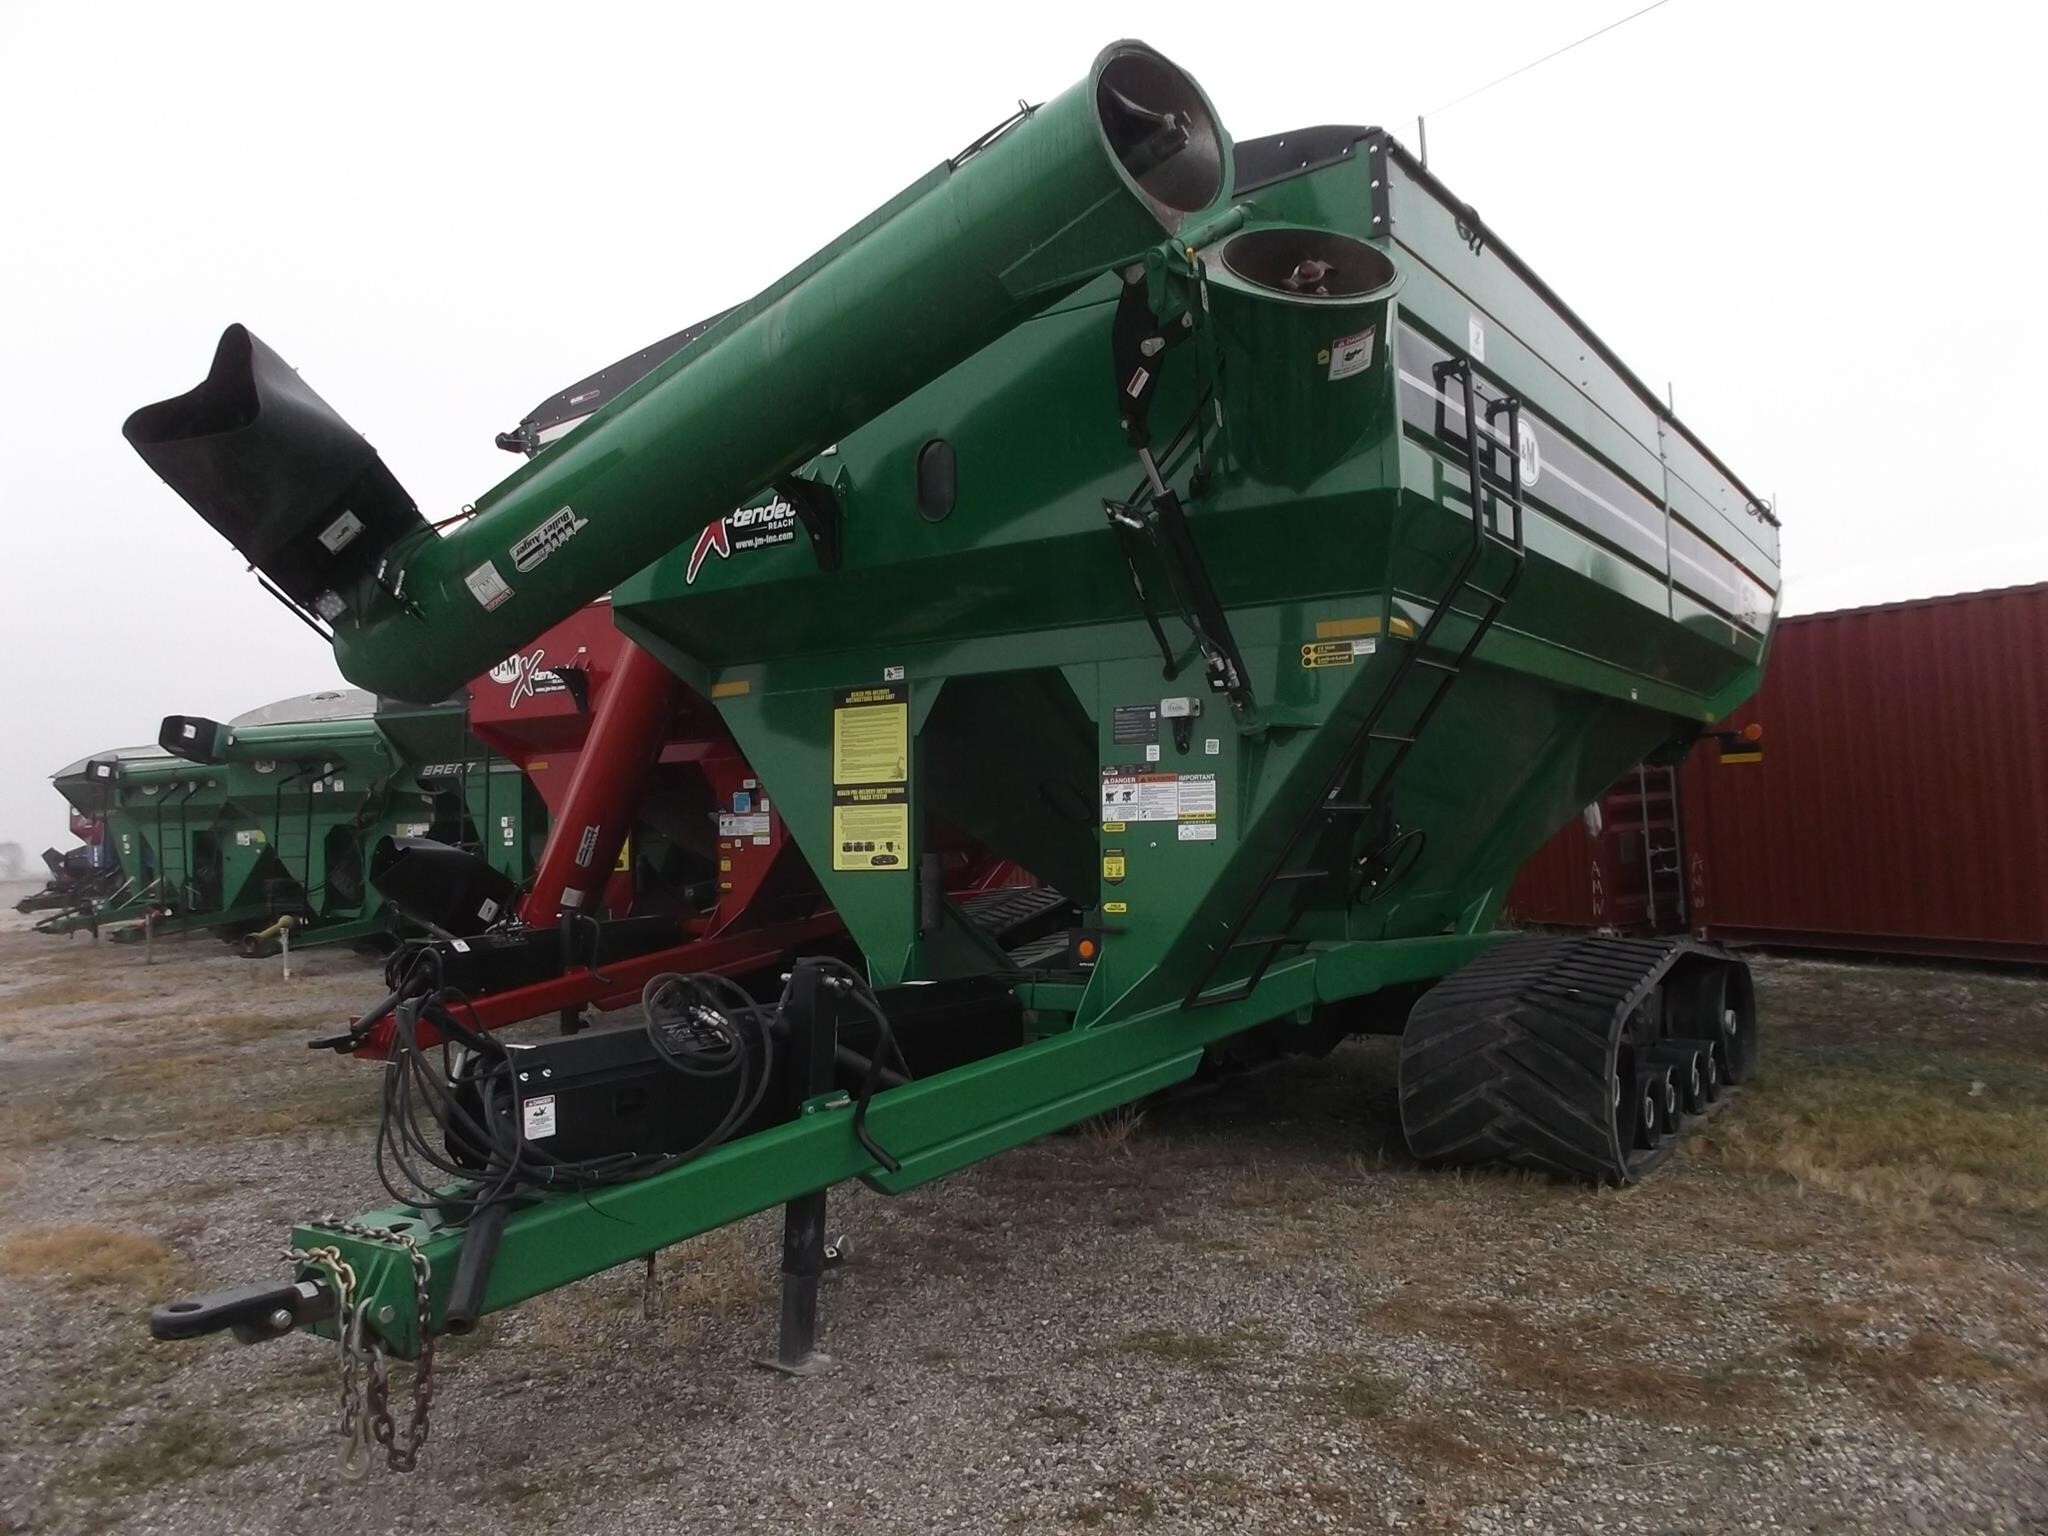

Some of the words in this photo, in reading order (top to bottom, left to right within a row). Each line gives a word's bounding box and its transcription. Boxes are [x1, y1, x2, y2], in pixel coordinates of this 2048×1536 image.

[543, 511, 570, 537] Bullet
[768, 518, 794, 531] REACH
[515, 533, 541, 557] Auger
[1109, 776, 1136, 784] DANGER
[1178, 773, 1216, 781] IMPORTANT
